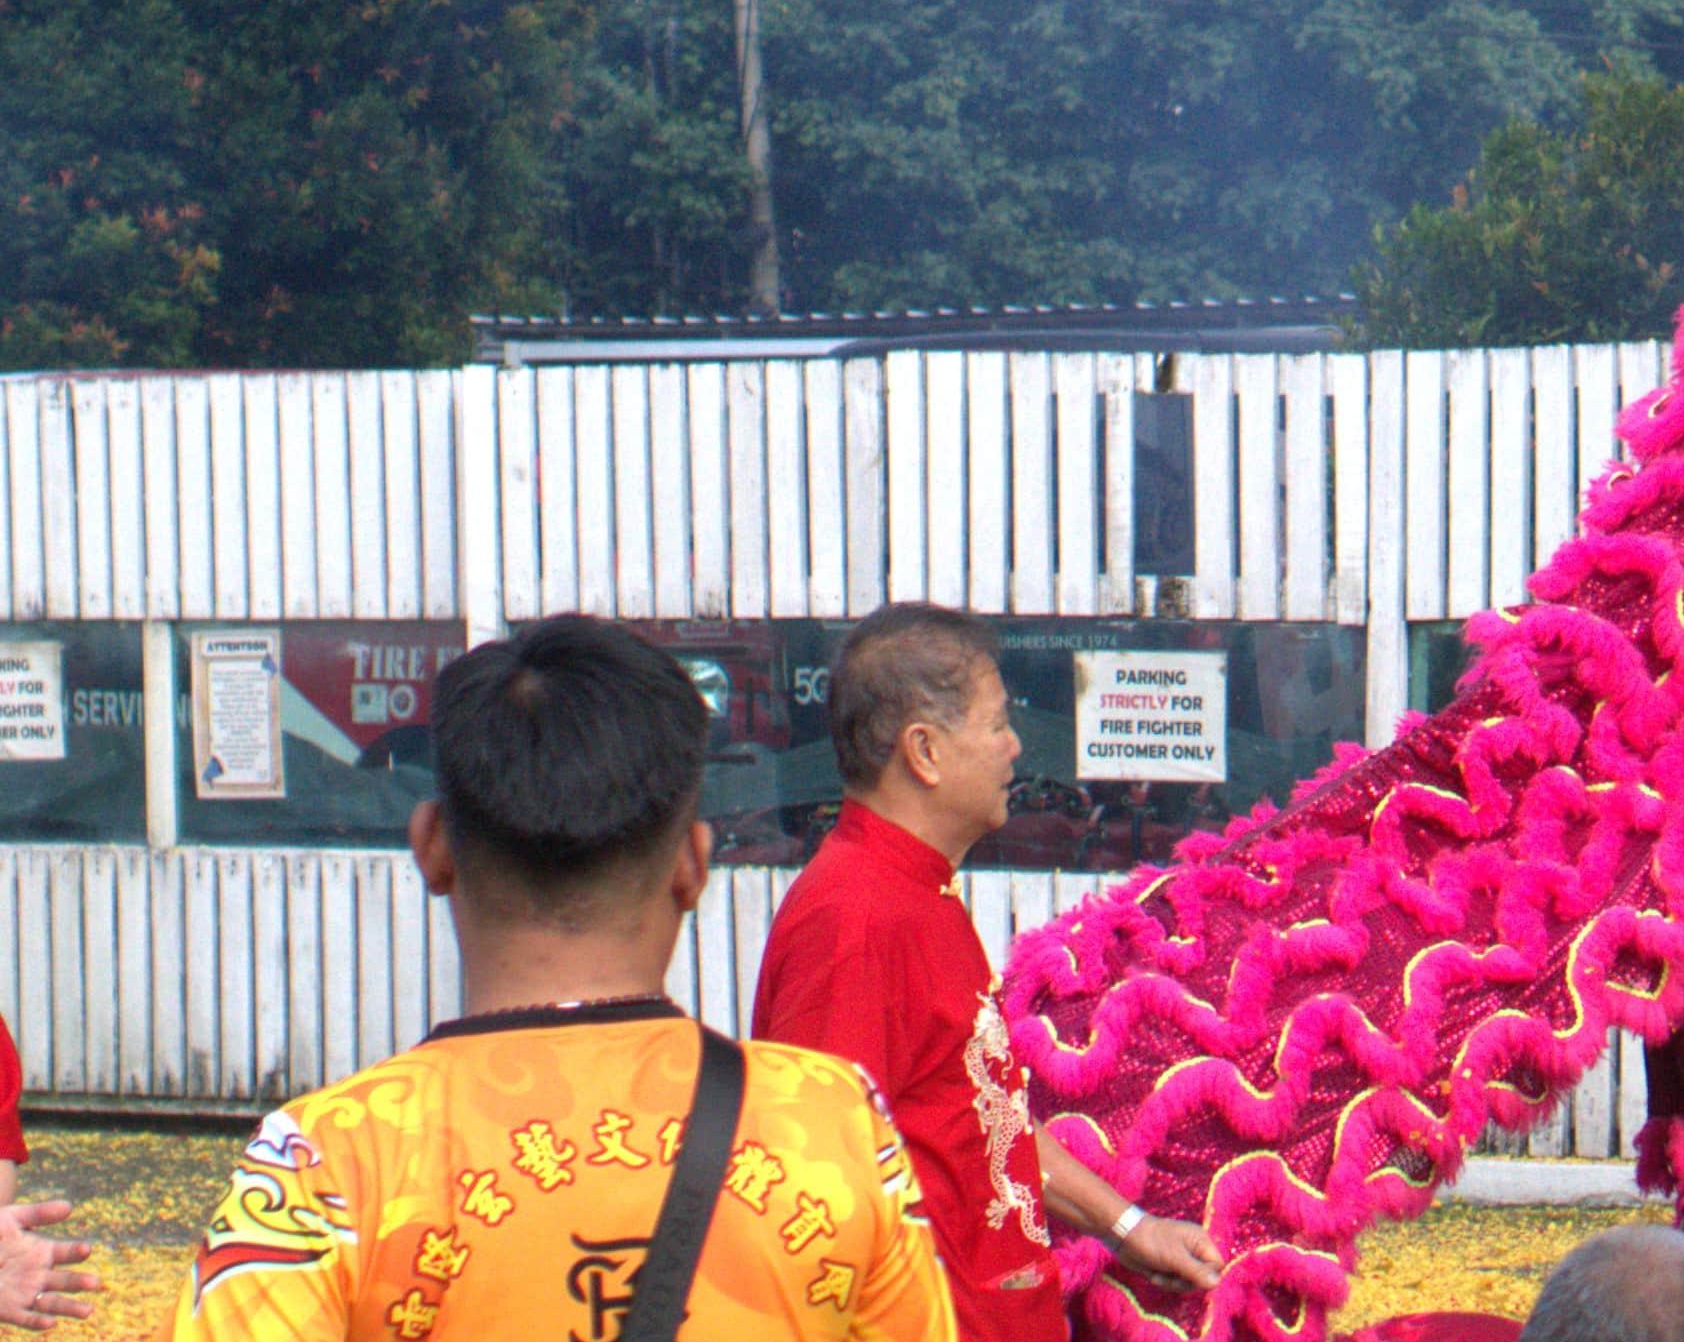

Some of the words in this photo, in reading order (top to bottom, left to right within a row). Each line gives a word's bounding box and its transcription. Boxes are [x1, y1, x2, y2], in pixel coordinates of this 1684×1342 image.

[1087, 634, 1118, 648] 1974
[1116, 669, 1187, 686] PARKING
[17, 681, 44, 695] FOR
[1100, 695, 1168, 711] STRICTLY
[1170, 695, 1203, 711] FOR
[20, 725, 55, 740] ONLY
[1100, 720, 1133, 736] FIRE
[1136, 720, 1203, 736] FIGHTER
[1087, 742, 1168, 759] CUSTOMER
[1171, 742, 1215, 760] ONLY
